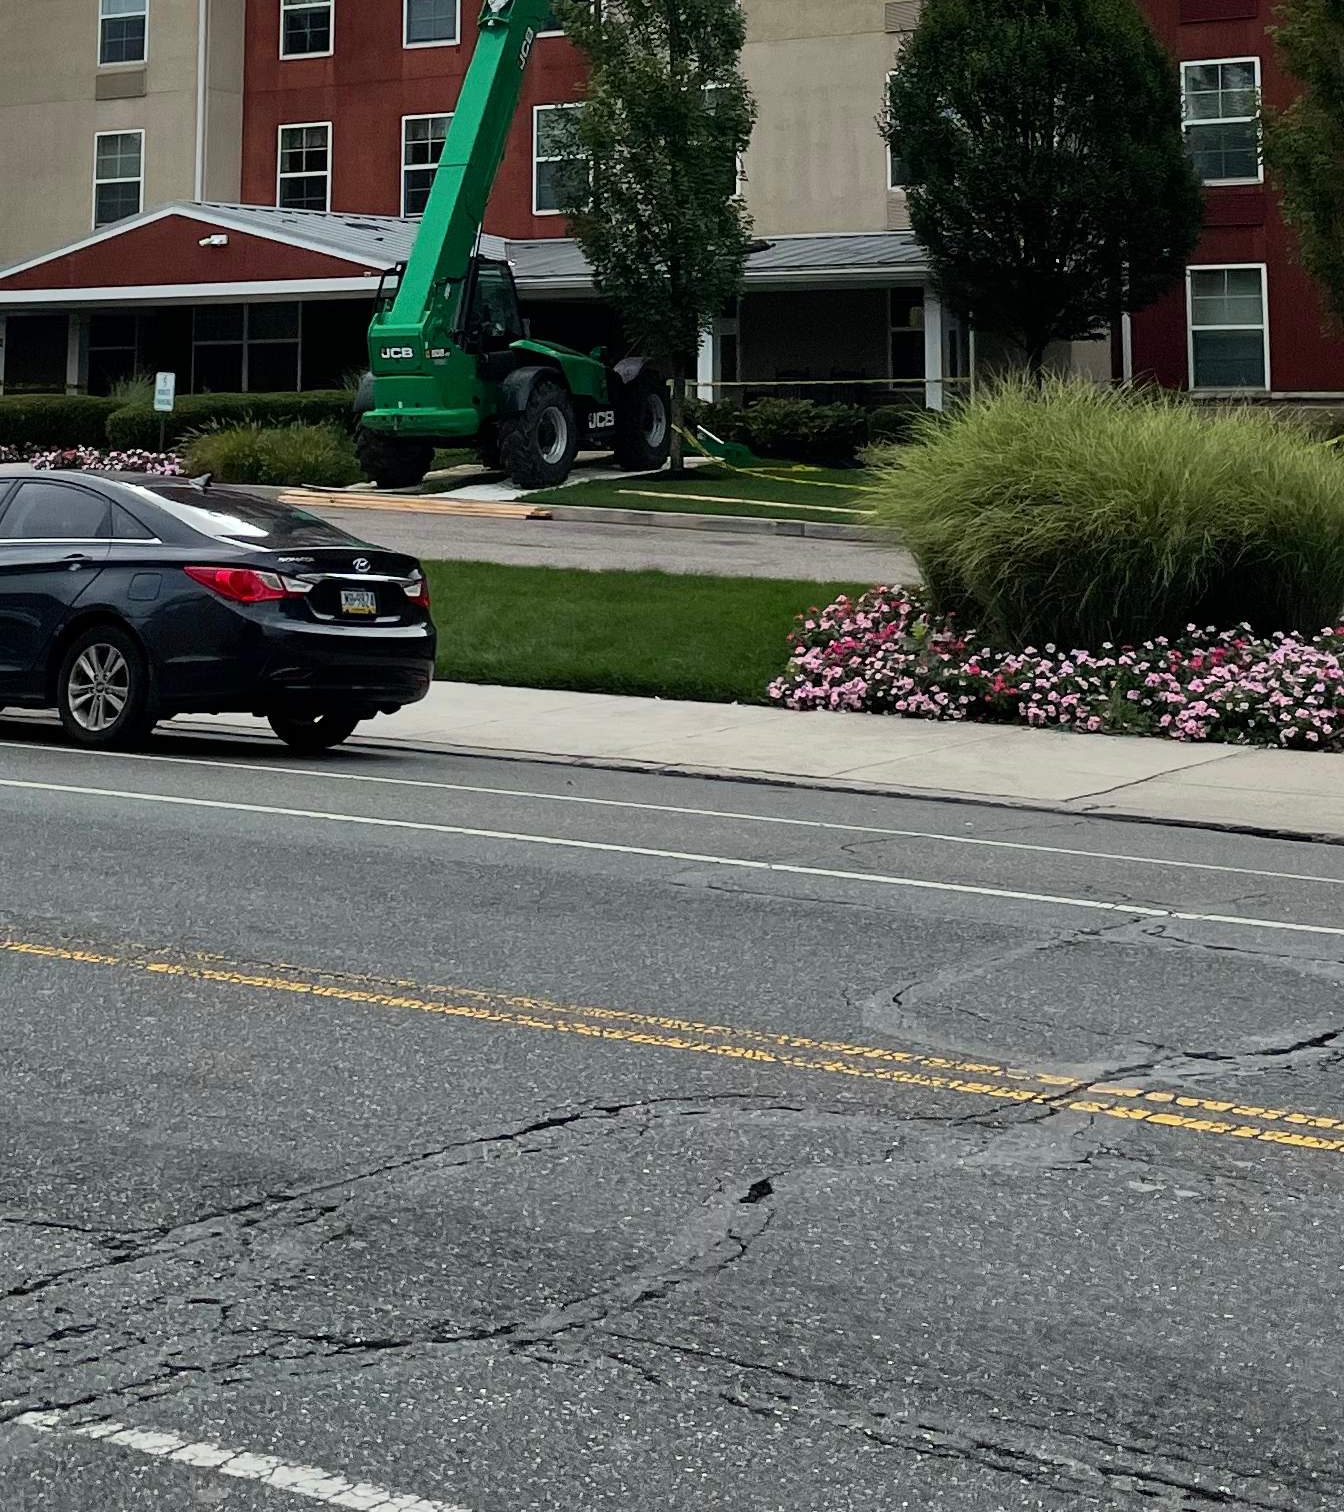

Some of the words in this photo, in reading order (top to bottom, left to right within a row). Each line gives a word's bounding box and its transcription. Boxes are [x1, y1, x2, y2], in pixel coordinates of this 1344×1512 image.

[520, 26, 534, 71] JCB
[381, 347, 414, 359] JCB
[588, 410, 615, 429] JCB
